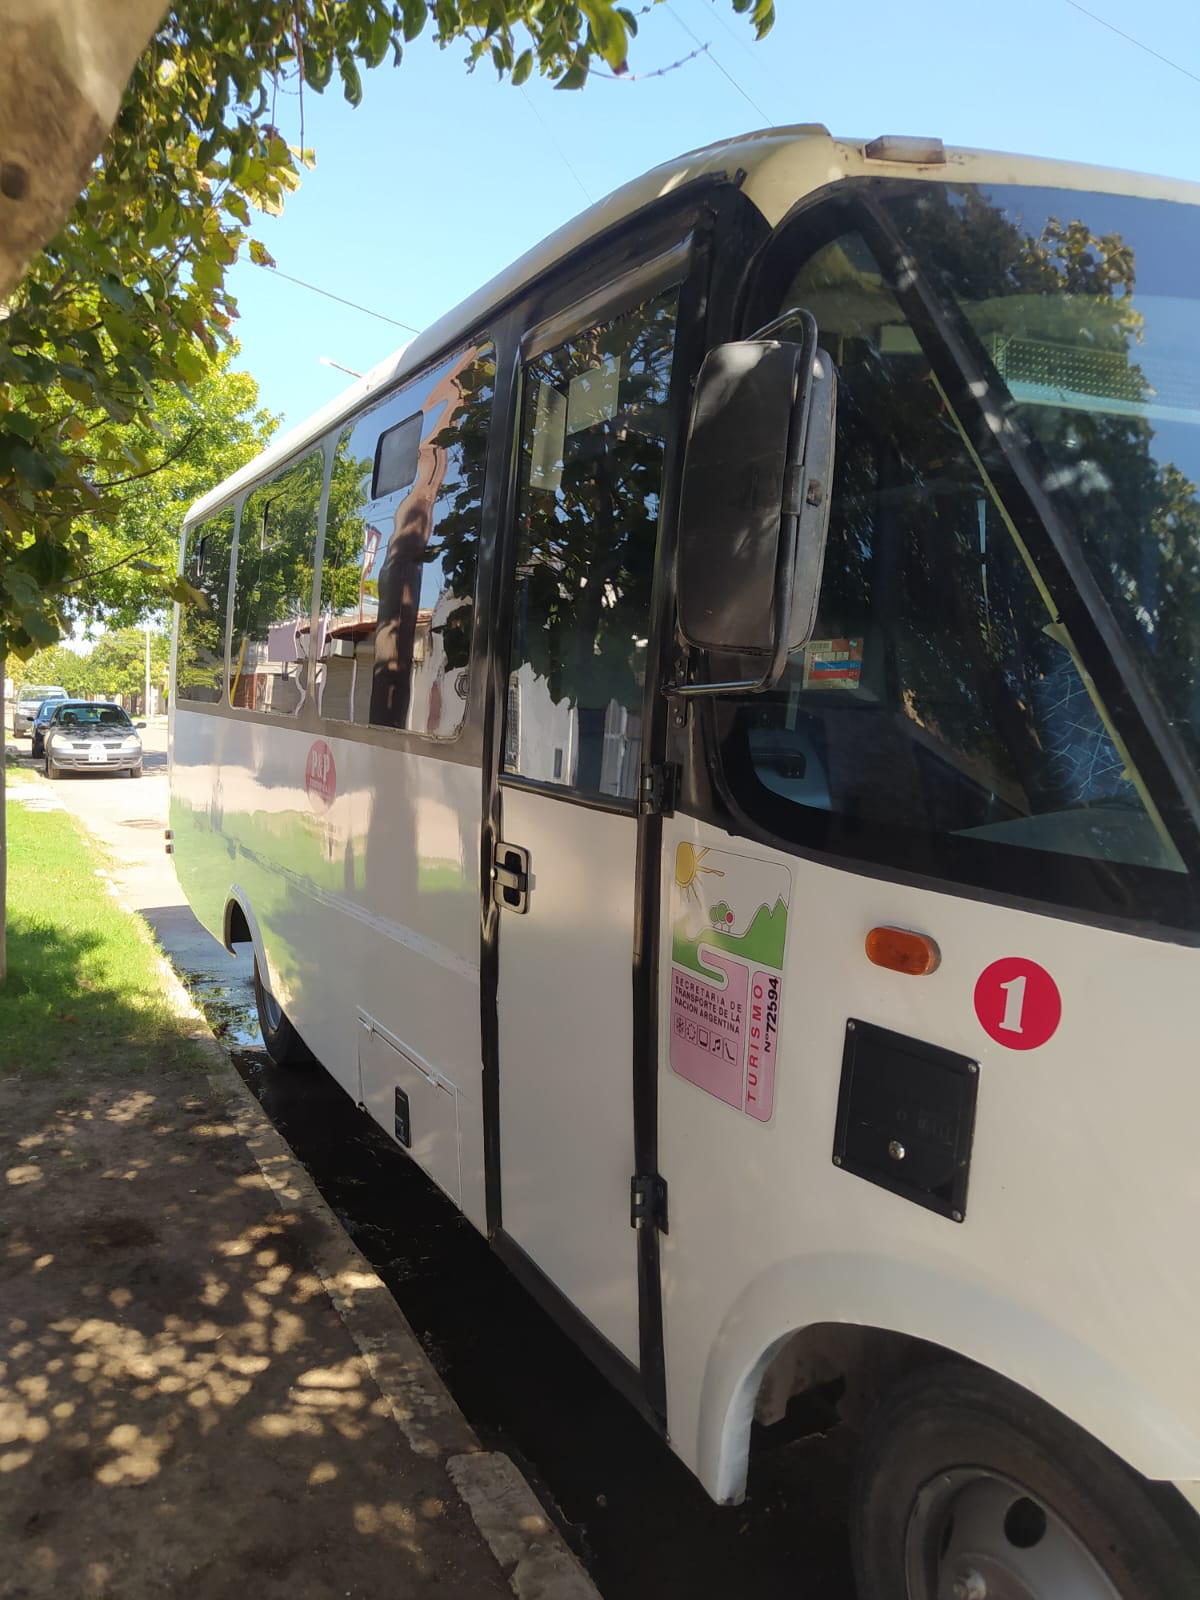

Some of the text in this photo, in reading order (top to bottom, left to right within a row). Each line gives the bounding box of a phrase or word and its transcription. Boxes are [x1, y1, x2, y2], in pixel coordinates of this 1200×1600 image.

[675, 976, 742, 1013] SECRETARIA DE
[675, 986, 741, 1024] TRANSPORTE DE LA
[999, 975, 1027, 1034] 1
[699, 1009, 740, 1034] ARGENTINA
[747, 984, 763, 1102] TURISMO
